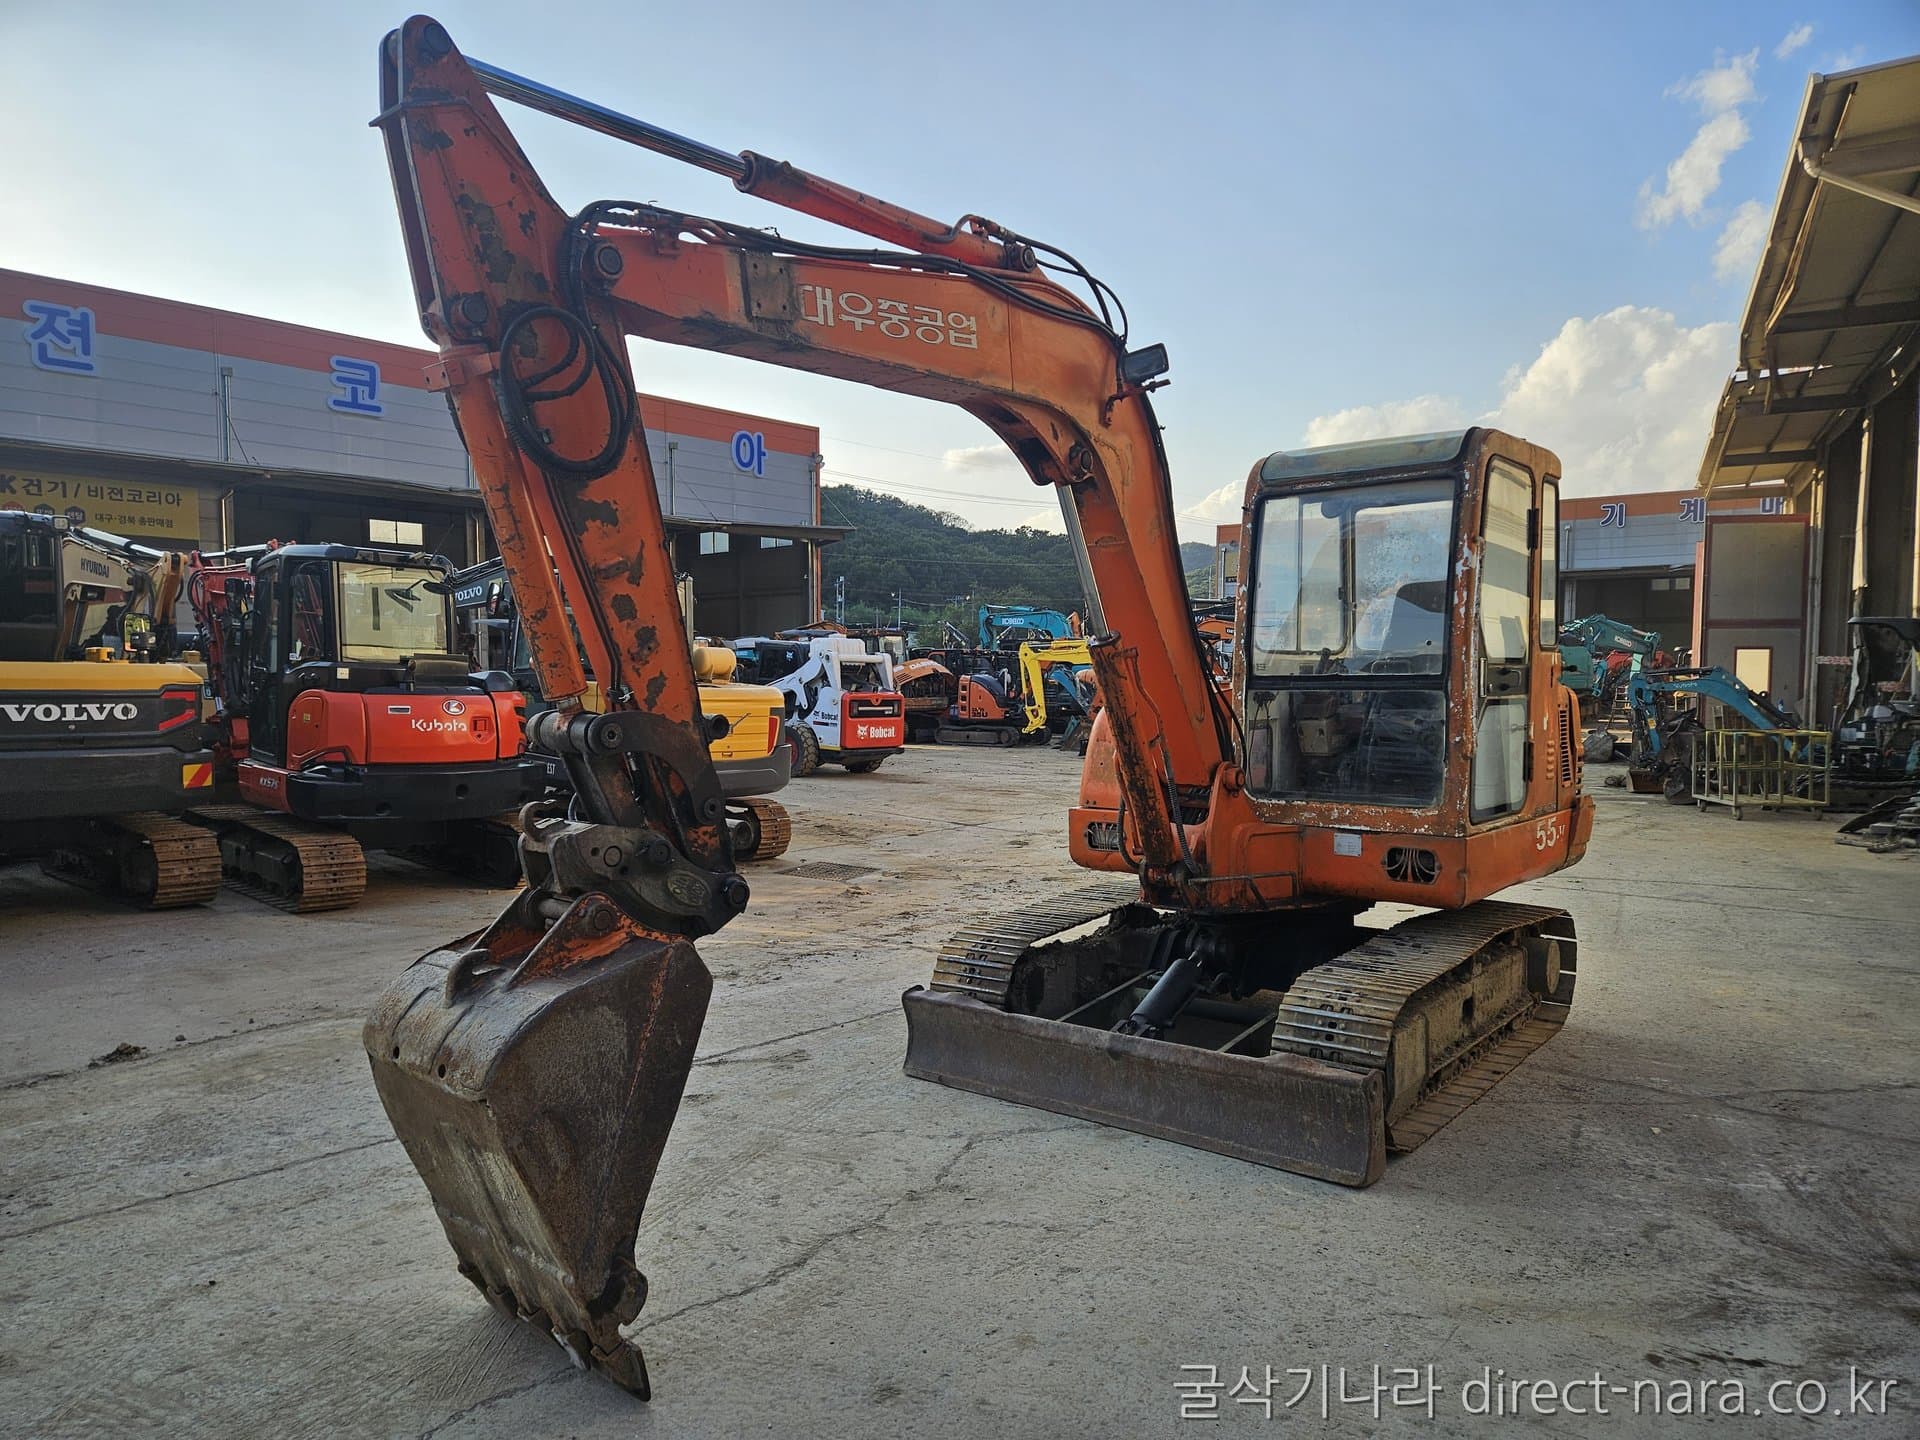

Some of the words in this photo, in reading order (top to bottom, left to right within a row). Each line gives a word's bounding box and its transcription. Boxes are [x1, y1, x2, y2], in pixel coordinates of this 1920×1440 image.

[800, 284, 978, 349] 대우중공업
[328, 356, 384, 416] 코
[732, 430, 768, 477] 아
[1600, 503, 1626, 527] 기
[1679, 497, 1706, 523] 계
[80, 557, 110, 578] HYUNDAI
[0, 704, 138, 722] VOLVO
[821, 712, 838, 720] Bobcat
[411, 719, 468, 732] Kubota
[869, 727, 896, 738] Bobcat
